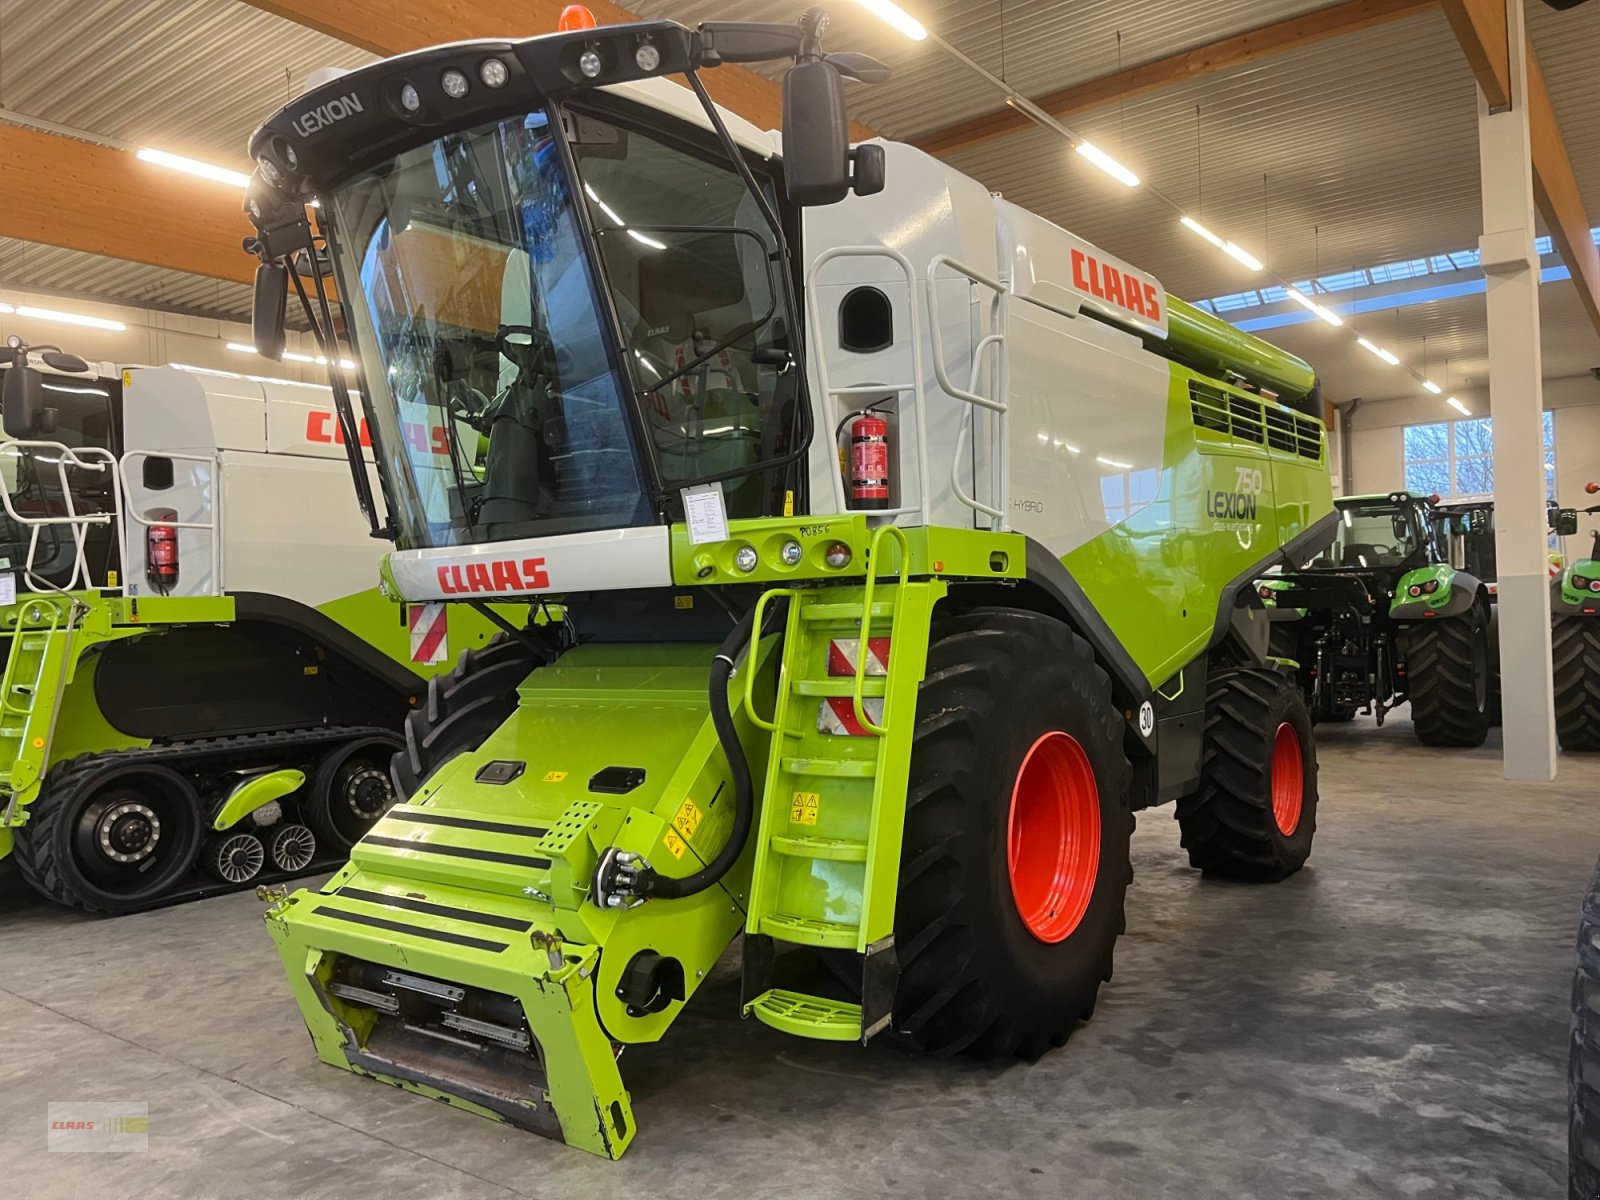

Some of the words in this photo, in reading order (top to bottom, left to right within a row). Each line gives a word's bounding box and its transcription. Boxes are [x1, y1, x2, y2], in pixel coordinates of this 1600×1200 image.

[292, 93, 364, 137] LEXION
[1071, 249, 1160, 321] CLAAS
[1235, 466, 1262, 496] 750
[1207, 490, 1257, 520] LEXION
[437, 557, 550, 594] CLAAS
[1141, 706, 1152, 730] 30
